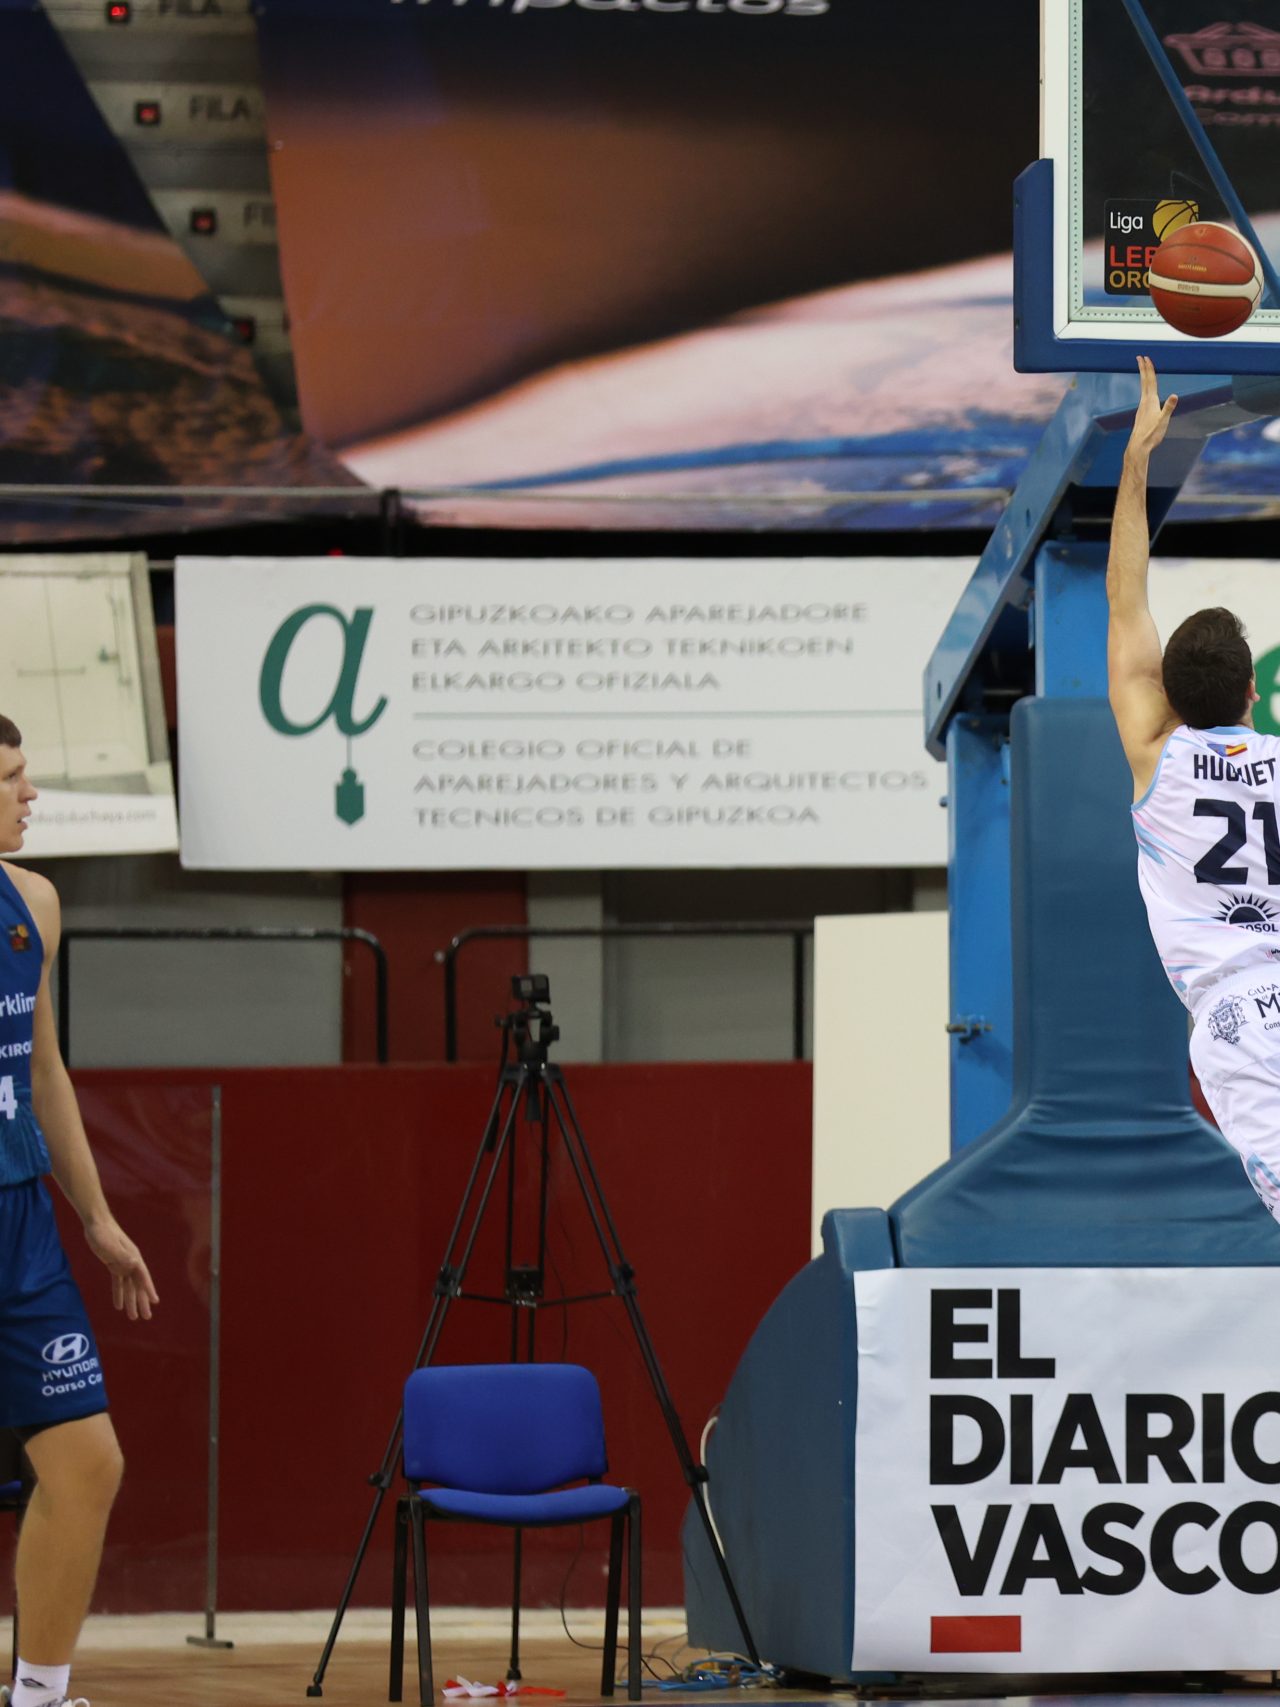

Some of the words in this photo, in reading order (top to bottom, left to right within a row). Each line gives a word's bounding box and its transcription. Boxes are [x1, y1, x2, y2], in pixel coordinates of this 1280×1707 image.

[1110, 211, 1143, 234] Liga
[409, 603, 635, 625] GIPUZKOAKO
[645, 602, 869, 624] APAREJADORE
[411, 637, 466, 659] ETA
[478, 637, 653, 658] ARKITEKTO
[666, 636, 854, 657] TEKNIKOEN
[411, 671, 565, 693] ELKARGO
[576, 671, 721, 692] OFIZIALA
[413, 739, 565, 761] COLEGIO
[576, 739, 701, 760] OFICIAL
[713, 738, 752, 759] DE
[413, 772, 657, 794] APAREJADORES
[669, 772, 688, 793] Y
[701, 770, 929, 792] ARQUITECTOS
[597, 805, 636, 827] DE
[648, 804, 820, 827] GIPUZKOA
[930, 1288, 1055, 1379] EL
[42, 1379, 86, 1396] Oarso
